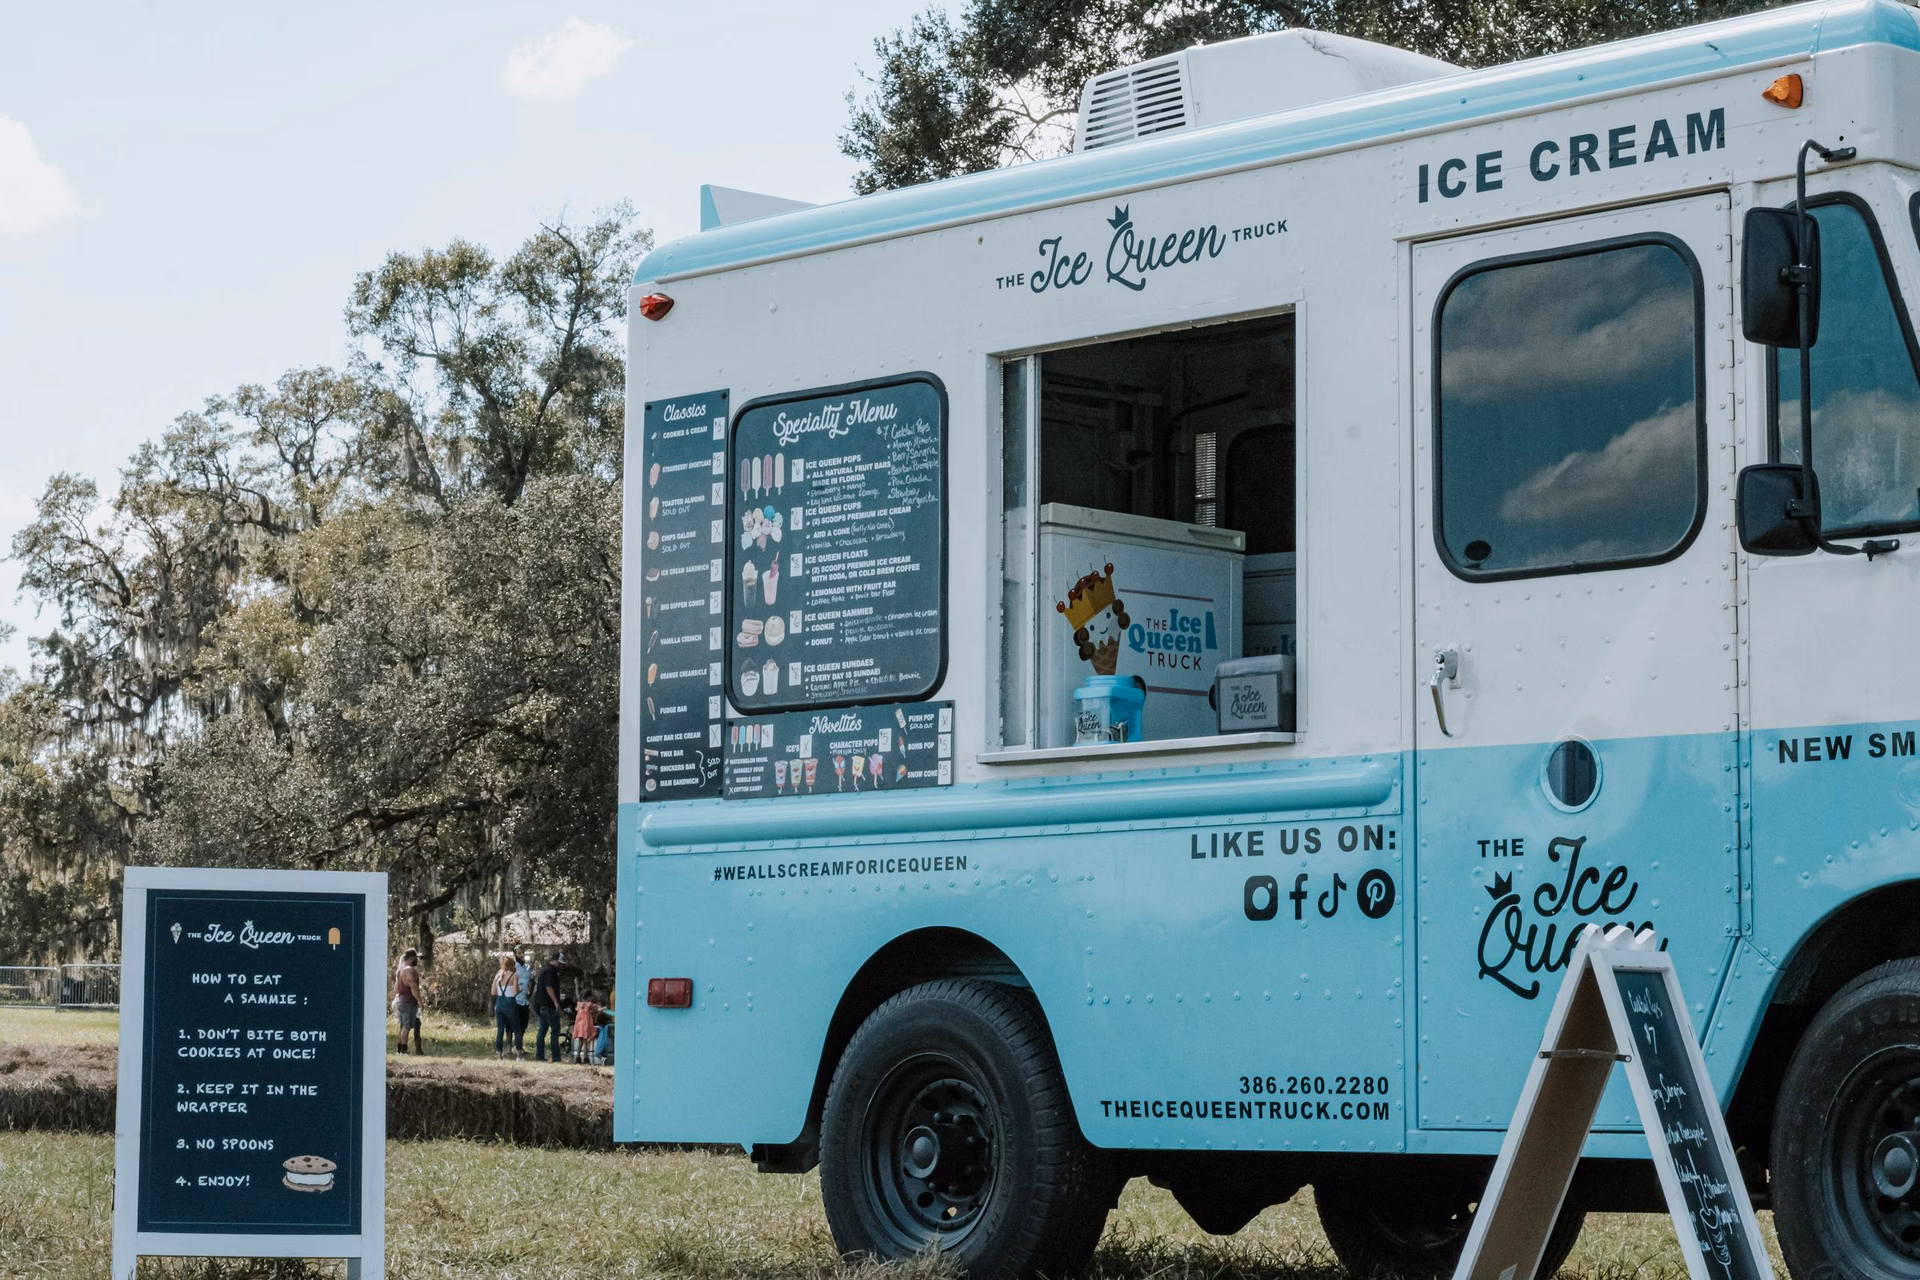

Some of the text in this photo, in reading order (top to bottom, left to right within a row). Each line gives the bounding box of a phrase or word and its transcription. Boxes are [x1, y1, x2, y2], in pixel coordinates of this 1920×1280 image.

[1418, 107, 1725, 203] ICE CREAM
[996, 220, 1288, 293] THE Ice Queen TRUCK
[664, 403, 706, 422] Classics
[773, 398, 898, 446] Specialty Menu
[663, 426, 707, 438] COOKIES CREAM
[806, 455, 861, 469] ICE QUEEN POPS
[825, 467, 853, 476] NATURAL
[874, 461, 891, 469] BARS
[839, 474, 865, 483] FLORIDA
[662, 495, 705, 507] TOASTED ALMOND
[662, 505, 690, 516] SOLD OUT
[806, 502, 861, 516] ICE QUEEN CUPS
[812, 518, 820, 526] (2)
[821, 515, 846, 524] SCOOPS
[847, 511, 876, 520] PREMIUM
[889, 506, 911, 515] CREAM
[662, 531, 696, 541] CHIPS GALORE
[805, 550, 868, 564] ICE QUEEN FLOATS
[669, 567, 685, 575] CREAM
[812, 556, 911, 575] (2) SCOOPS PREMIUM ICE CREAM
[812, 574, 827, 582] WITH
[859, 569, 875, 577] COLD
[877, 566, 895, 575] BREW
[896, 563, 920, 572] COFFEE
[812, 587, 845, 597] LEMONADE
[670, 601, 688, 609] DIPPER
[688, 600, 705, 608] CONES
[818, 611, 840, 620] QUEEN
[842, 607, 873, 617] SAMMIES
[1146, 609, 1202, 632] THE Ice
[811, 623, 835, 631] COOKIE
[811, 638, 833, 646] DONUT
[1128, 623, 1202, 653] Queen
[817, 663, 841, 671] QUEEN
[842, 659, 874, 669] SUNDAES
[1147, 651, 1202, 670] TRUCK
[811, 674, 831, 682] EVERY
[1242, 685, 1261, 701] Ice
[1231, 699, 1267, 719] Queen
[809, 714, 862, 734] Novelties
[830, 740, 863, 749] CHARACTER
[1779, 731, 1915, 763] NEW SM
[1191, 824, 1396, 859] LIKE US ON:
[714, 856, 967, 881] #WEALLSCREAMFORICEQUEEN
[1478, 836, 1638, 917] THE Ice
[204, 923, 235, 944] Ice
[240, 925, 295, 948] Queen
[192, 973, 282, 985] HOW TO EAT
[225, 994, 296, 1004] A SAMMIE
[179, 1029, 326, 1041] 1. DON'T BITE BOTH
[178, 1047, 316, 1059] COOKIES AT ONCE!
[177, 1084, 318, 1095] 2. KEEP IT IN THE
[1239, 1076, 1389, 1095] 386.260.2280
[177, 1102, 248, 1114] WRAPPER
[1101, 1100, 1389, 1120] THEICEQUEENTRUCK.COM
[177, 1139, 274, 1150] 3. NO SPOONS
[175, 1175, 250, 1187] 4. ENJOY!
